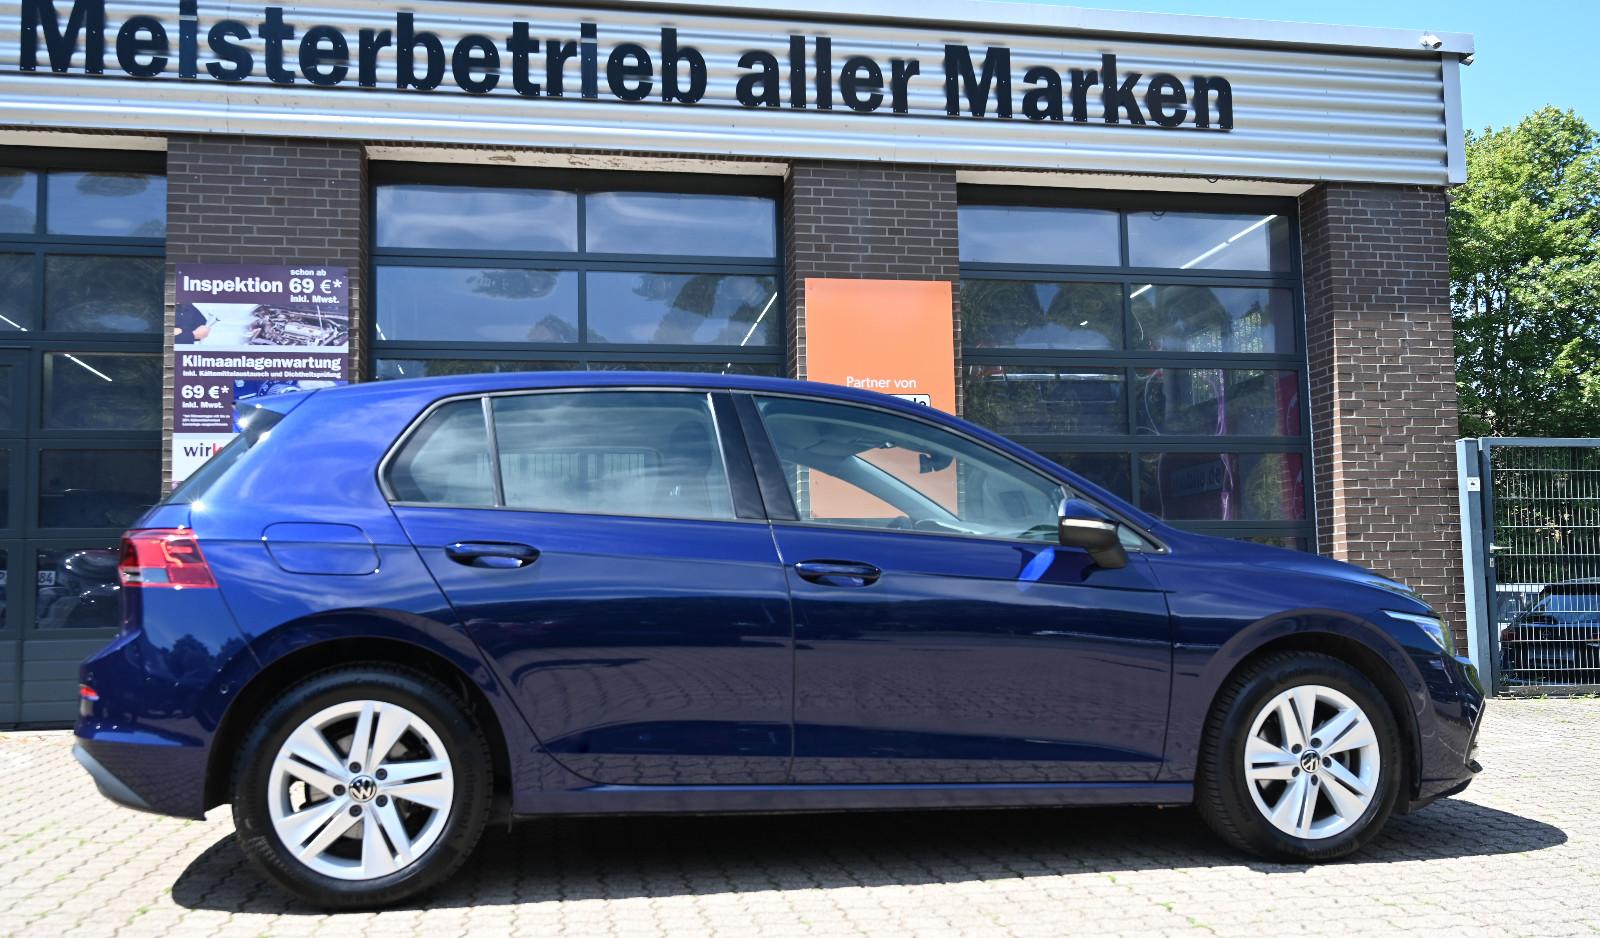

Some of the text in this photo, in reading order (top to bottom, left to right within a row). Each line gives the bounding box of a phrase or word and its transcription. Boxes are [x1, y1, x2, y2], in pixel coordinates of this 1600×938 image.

[20, 0, 1234, 131] Meisterbetrieb aller Marken
[290, 268, 314, 276] schon
[183, 276, 283, 295] Inspektion
[289, 278, 315, 294] 69
[312, 295, 340, 303] Mwst.
[182, 355, 342, 371] Klimaanlagenwartung
[846, 376, 917, 389] Partner von
[181, 384, 205, 399] 69
[200, 401, 224, 409] Mwst.
